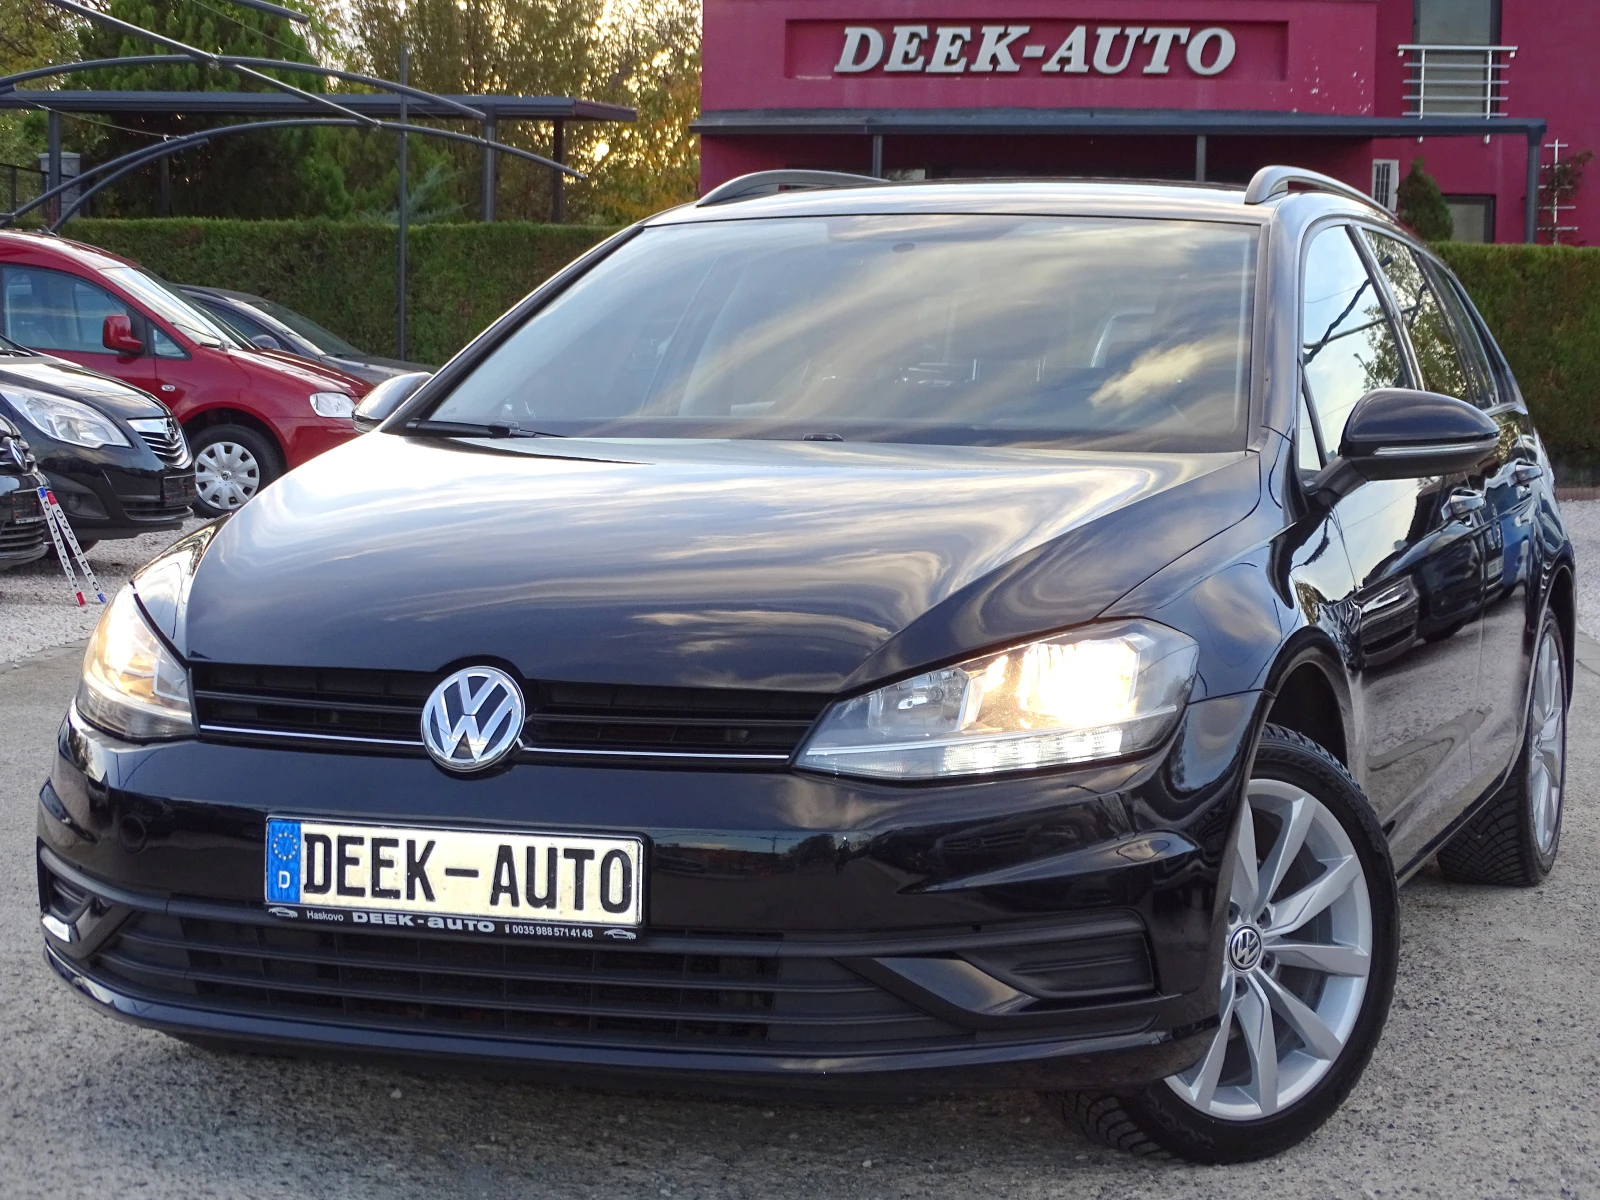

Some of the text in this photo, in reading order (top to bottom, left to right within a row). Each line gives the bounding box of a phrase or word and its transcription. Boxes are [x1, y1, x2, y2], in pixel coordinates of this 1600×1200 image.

[834, 25, 1236, 75] DEEK-AUTO
[278, 870, 291, 889] D
[306, 910, 344, 922] Haskovo
[514, 923, 535, 936] 0035
